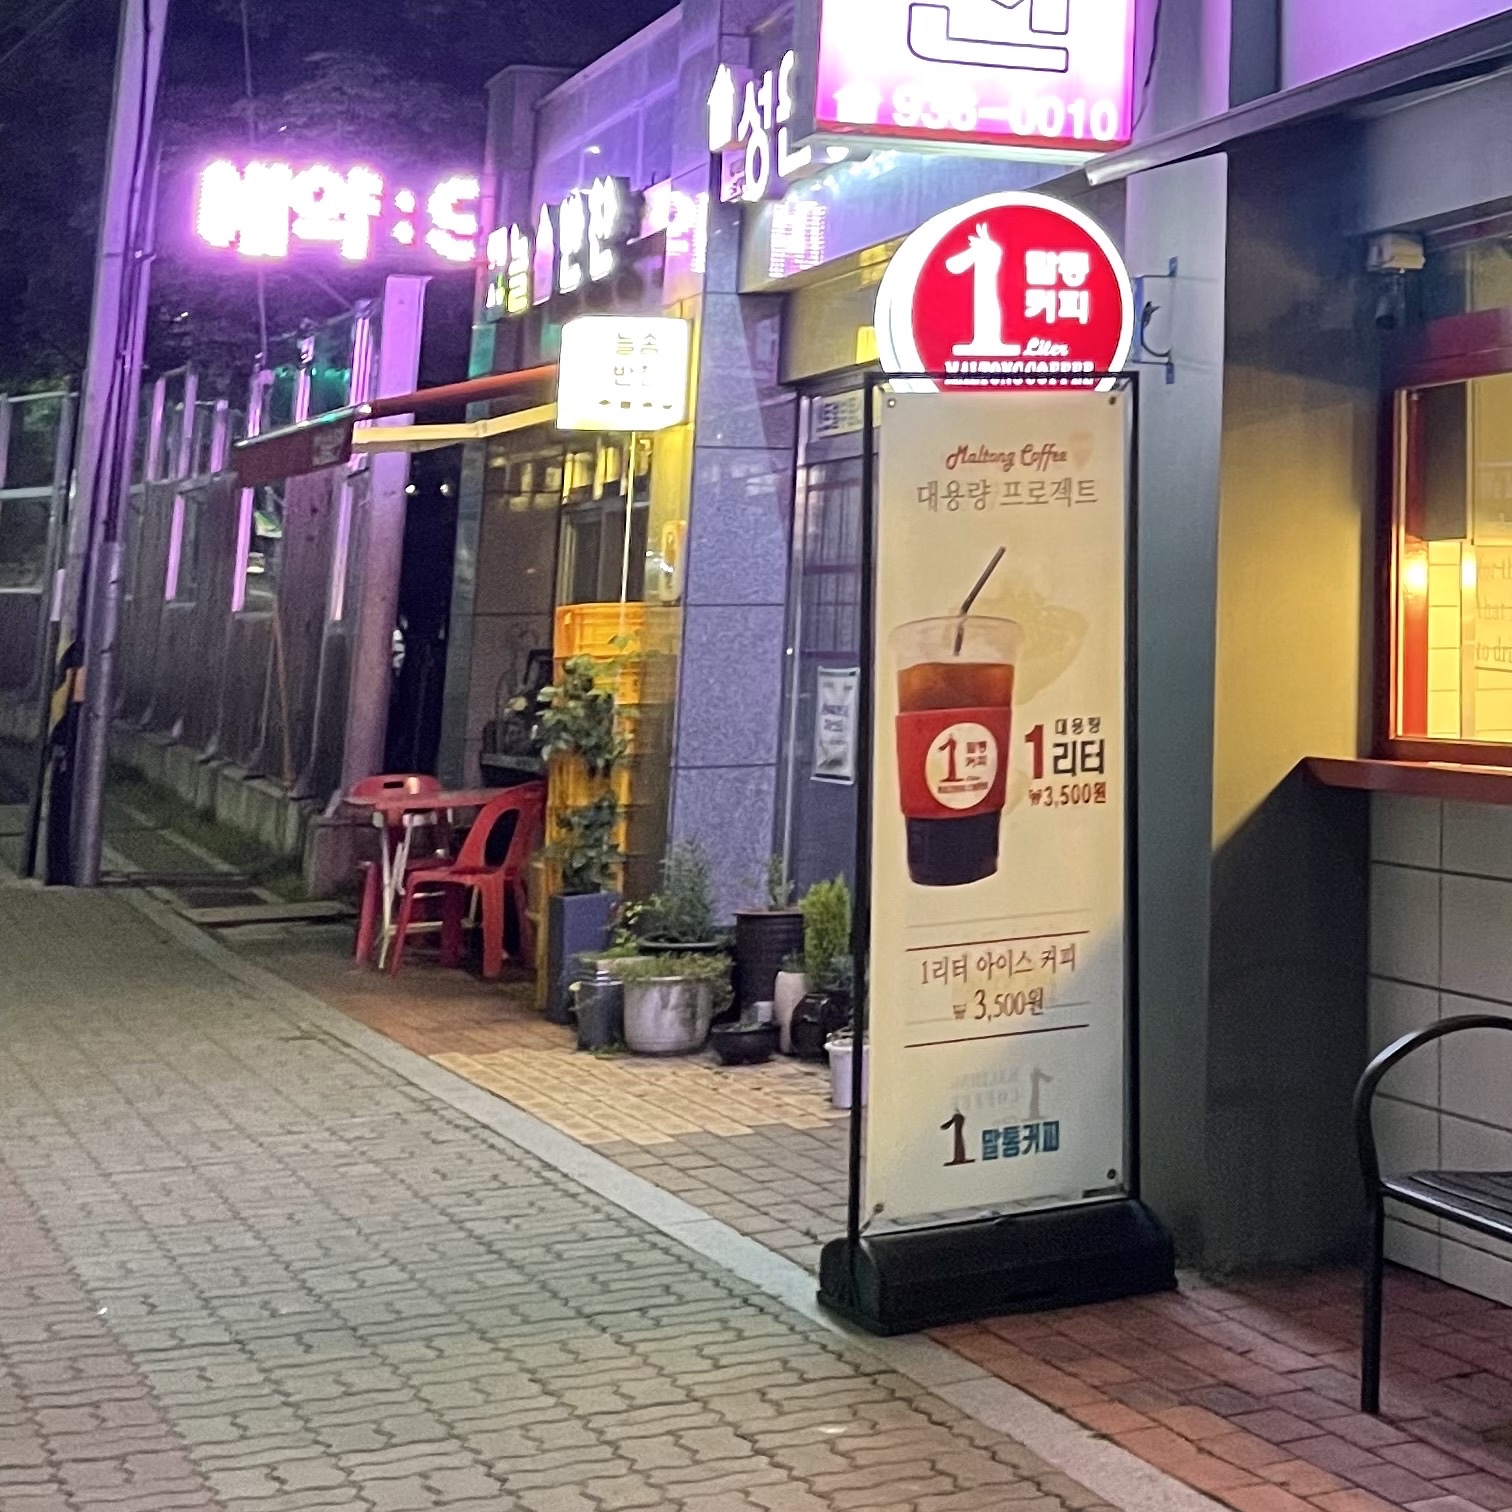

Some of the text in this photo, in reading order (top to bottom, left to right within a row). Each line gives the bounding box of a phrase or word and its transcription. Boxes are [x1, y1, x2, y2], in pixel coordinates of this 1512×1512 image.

[944, 223, 1021, 356] 1
[945, 443, 1067, 472] Maltong Coffee
[917, 477, 1098, 512] 대용량 프로젝트
[1477, 595, 1506, 622] that
[1476, 640, 1491, 661] to
[921, 943, 1076, 985] 1리터 아이스 커피
[974, 987, 1043, 1022] 3,500원
[940, 1109, 976, 1167] 1
